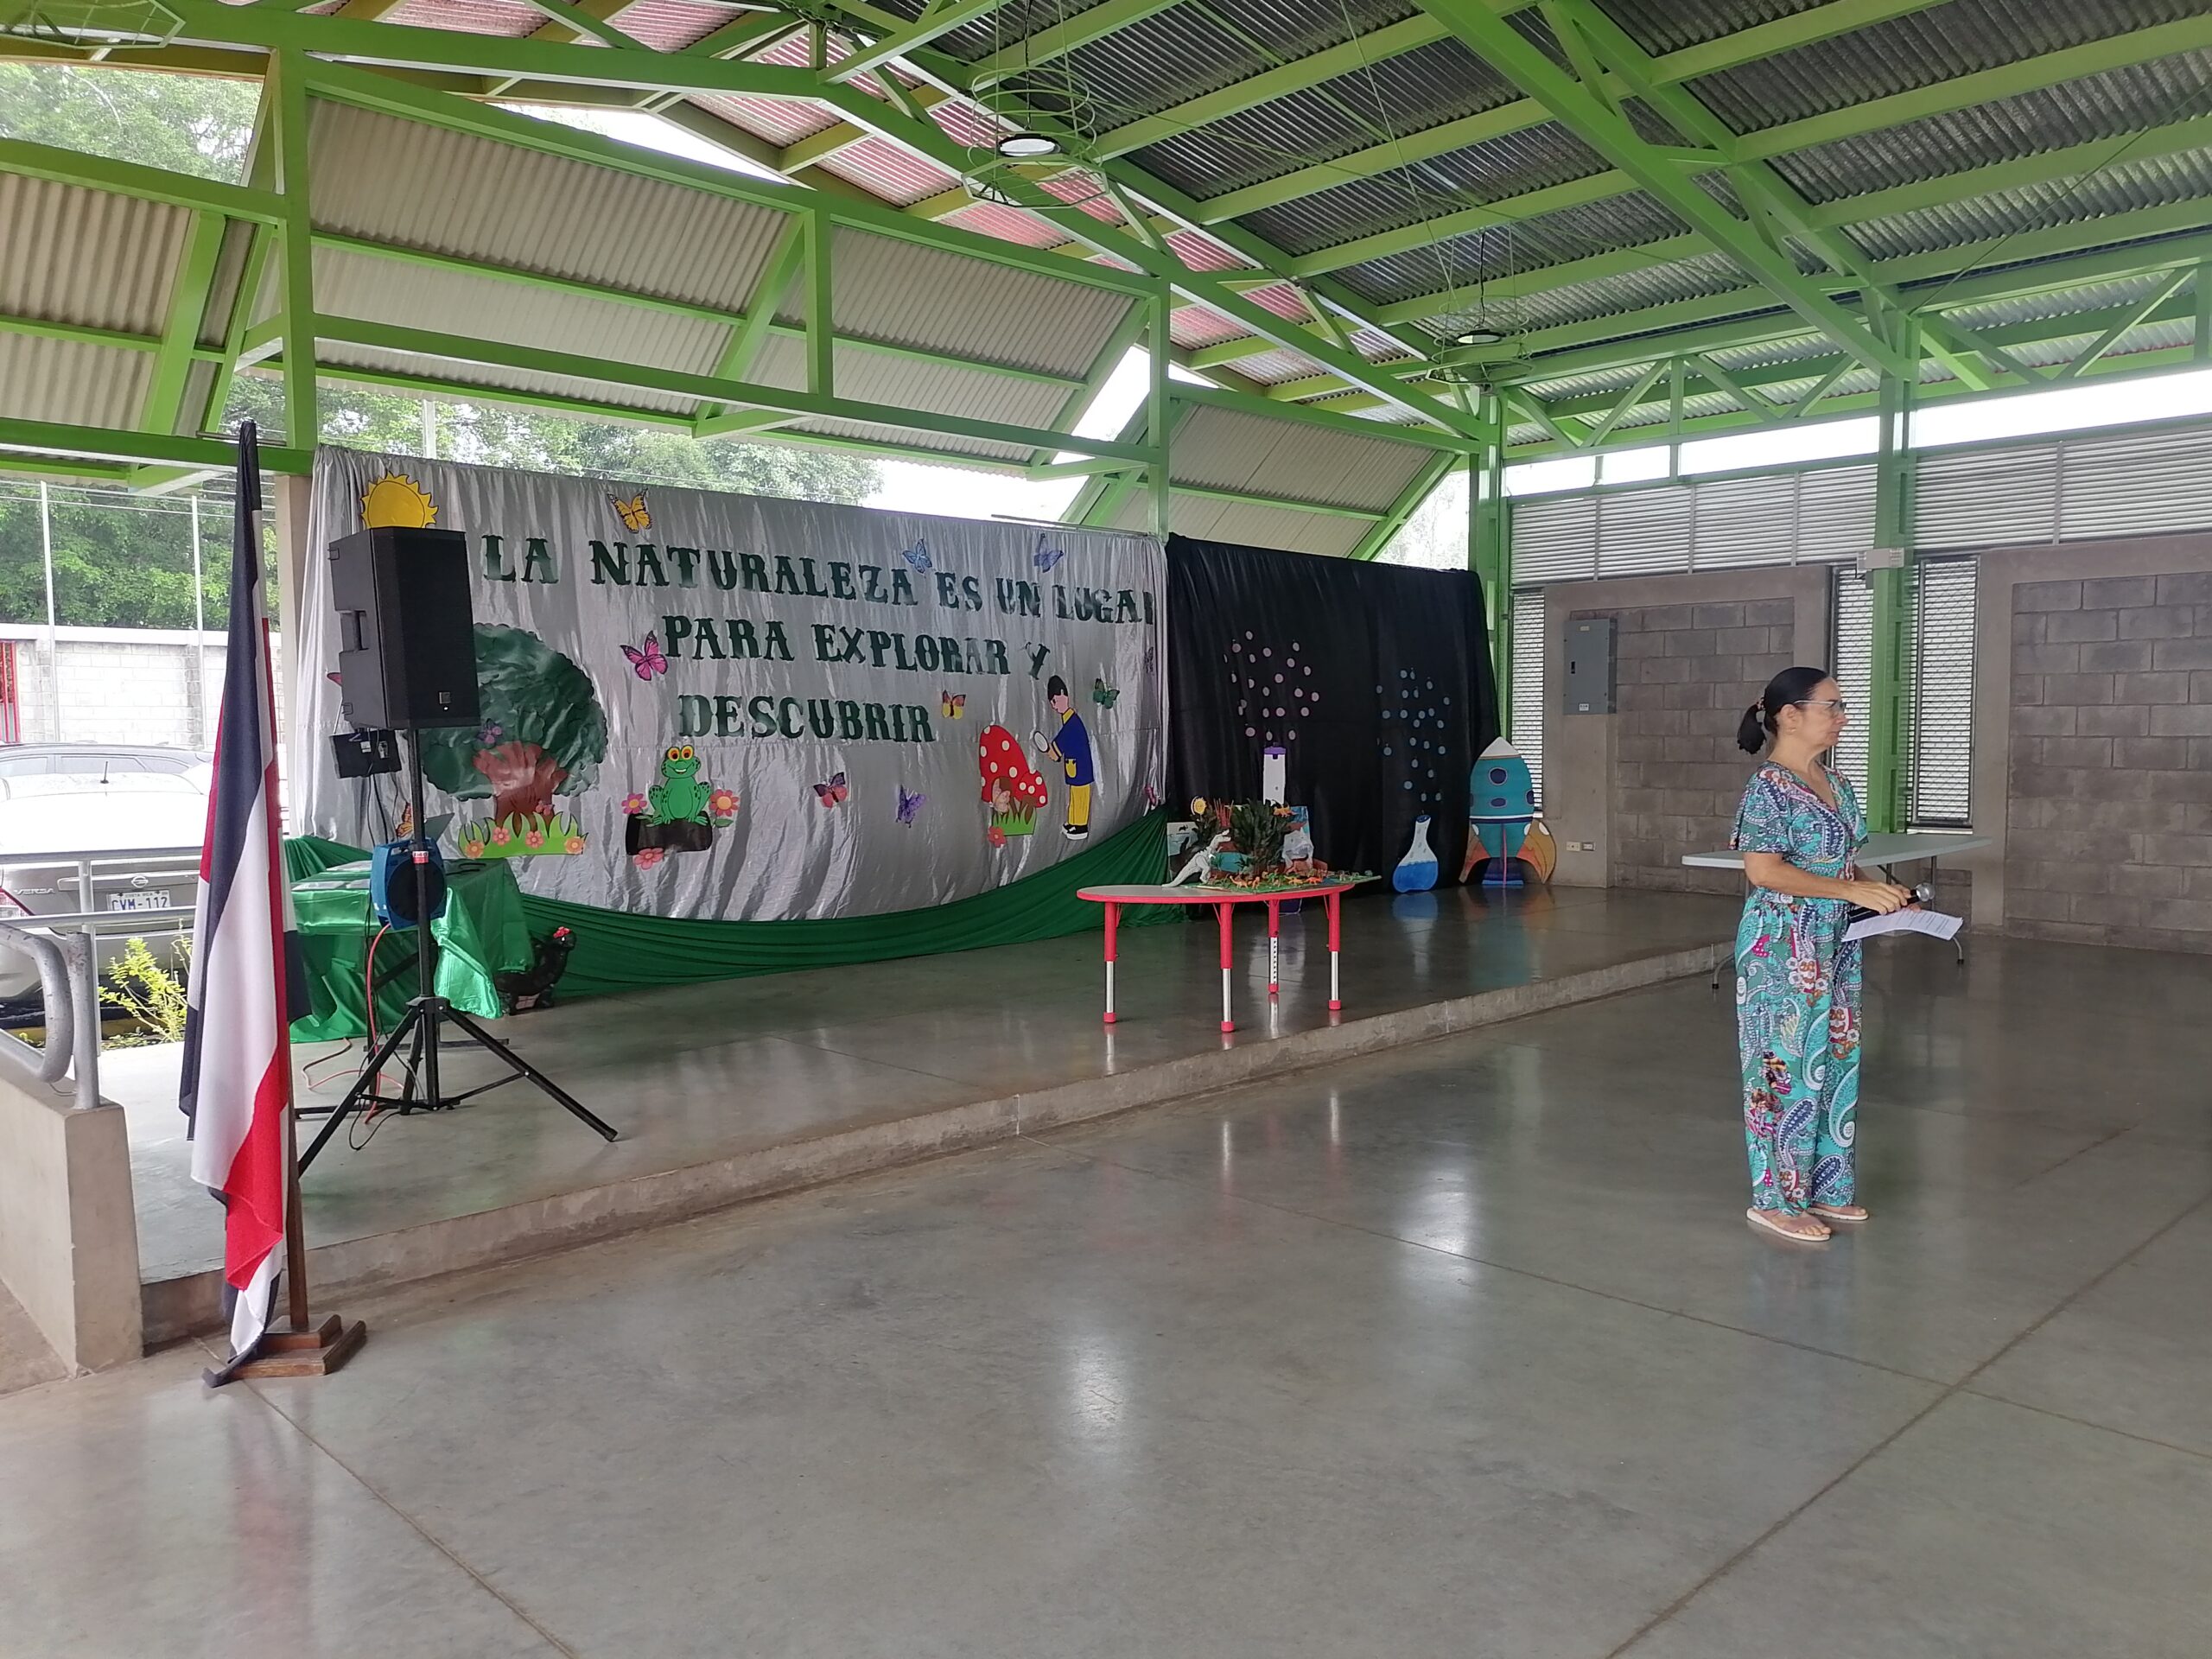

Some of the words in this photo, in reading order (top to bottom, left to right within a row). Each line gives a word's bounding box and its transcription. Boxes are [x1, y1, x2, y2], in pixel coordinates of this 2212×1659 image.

[482, 534, 559, 584] LA
[589, 540, 918, 606] NATURALEZA
[935, 571, 982, 612] ES
[995, 577, 1040, 618] UN
[662, 615, 794, 661] PARA
[810, 623, 1011, 675] EXPLORAR
[1025, 641, 1051, 680] Y
[678, 694, 936, 743] DESCUBRIR
